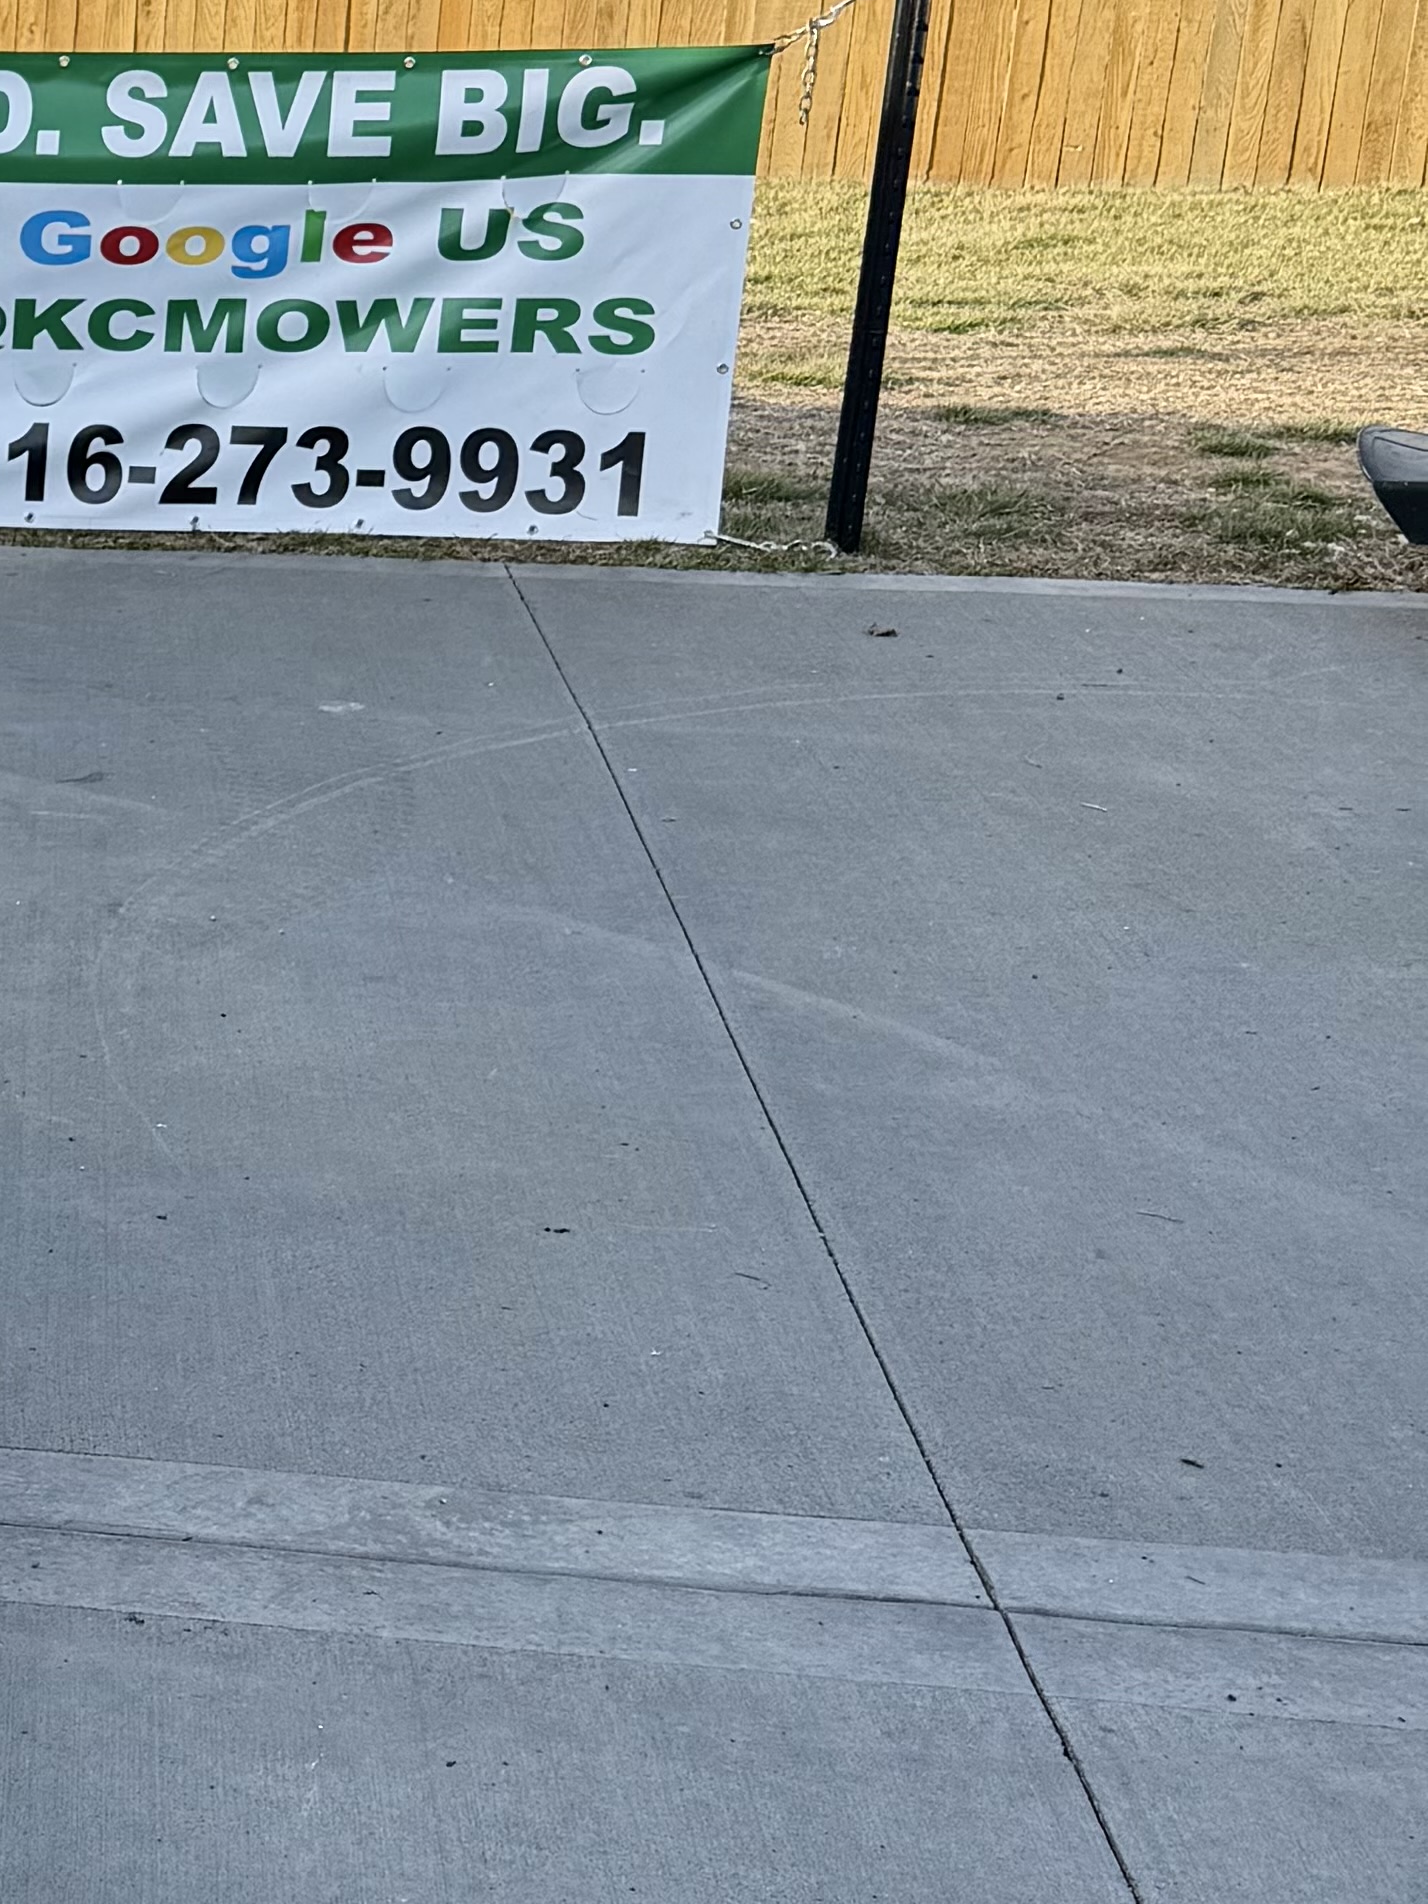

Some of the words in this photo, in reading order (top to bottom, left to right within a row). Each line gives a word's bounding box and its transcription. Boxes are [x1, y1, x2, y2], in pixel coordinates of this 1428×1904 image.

[101, 69, 396, 157] SAVE
[435, 66, 665, 156] BIG.
[19, 208, 394, 279] Google
[437, 202, 585, 261] US
